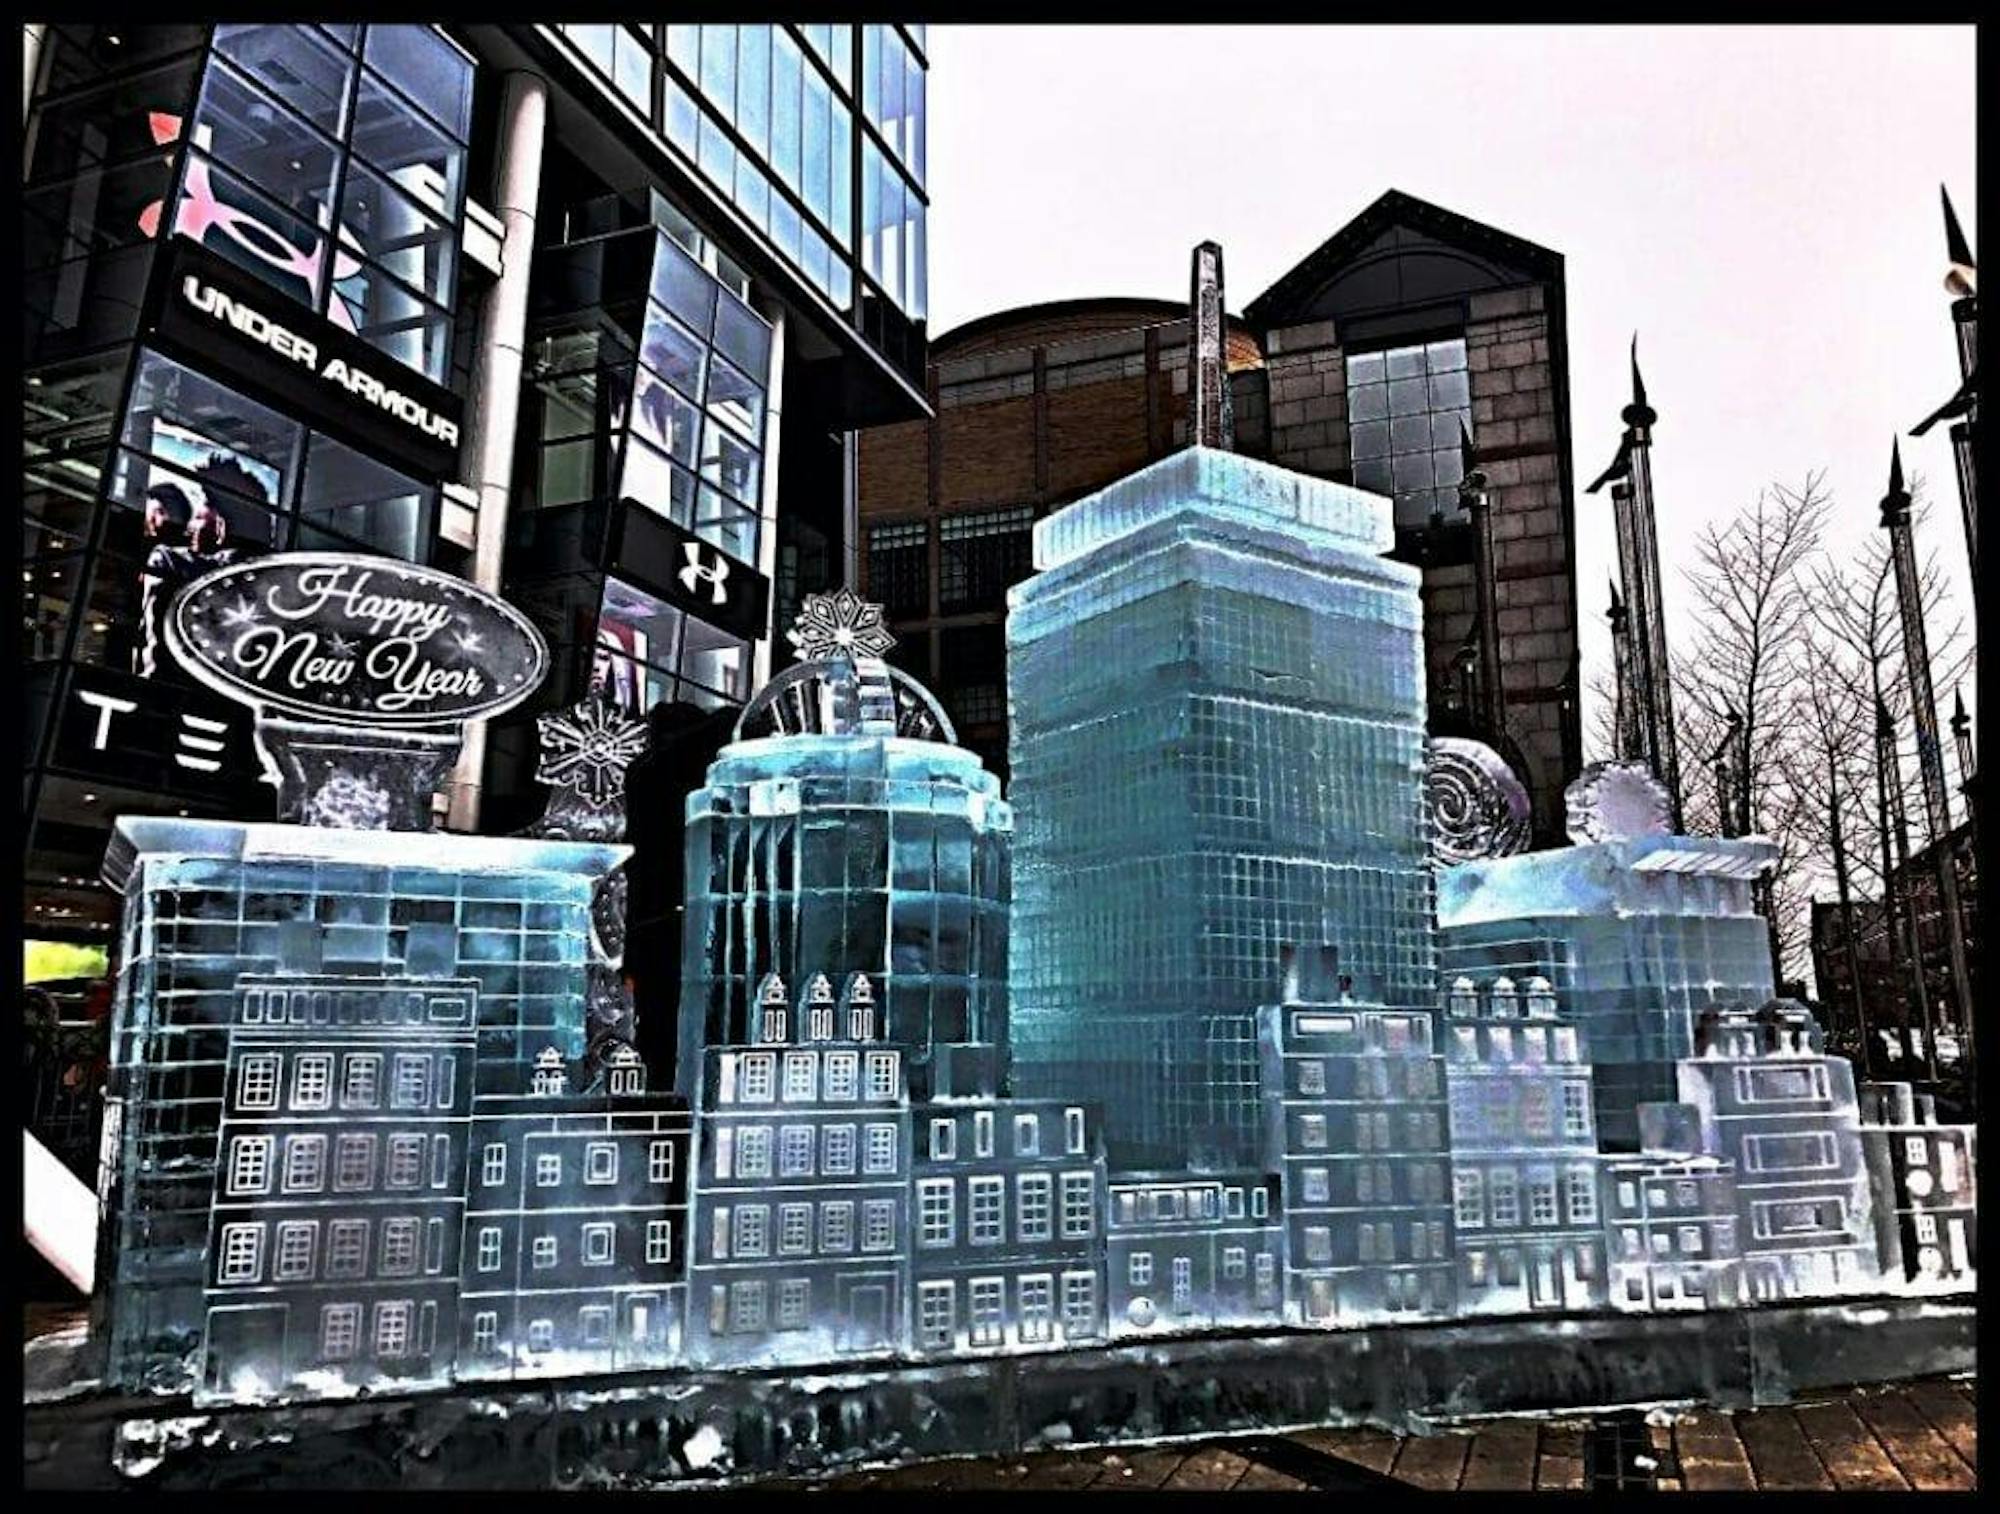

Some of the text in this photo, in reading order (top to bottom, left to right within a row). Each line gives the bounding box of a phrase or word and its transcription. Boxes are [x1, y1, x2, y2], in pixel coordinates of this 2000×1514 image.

[182, 275, 459, 448] UNDER ARMOUR
[267, 565, 451, 642] Happy
[233, 625, 484, 711] New Year
